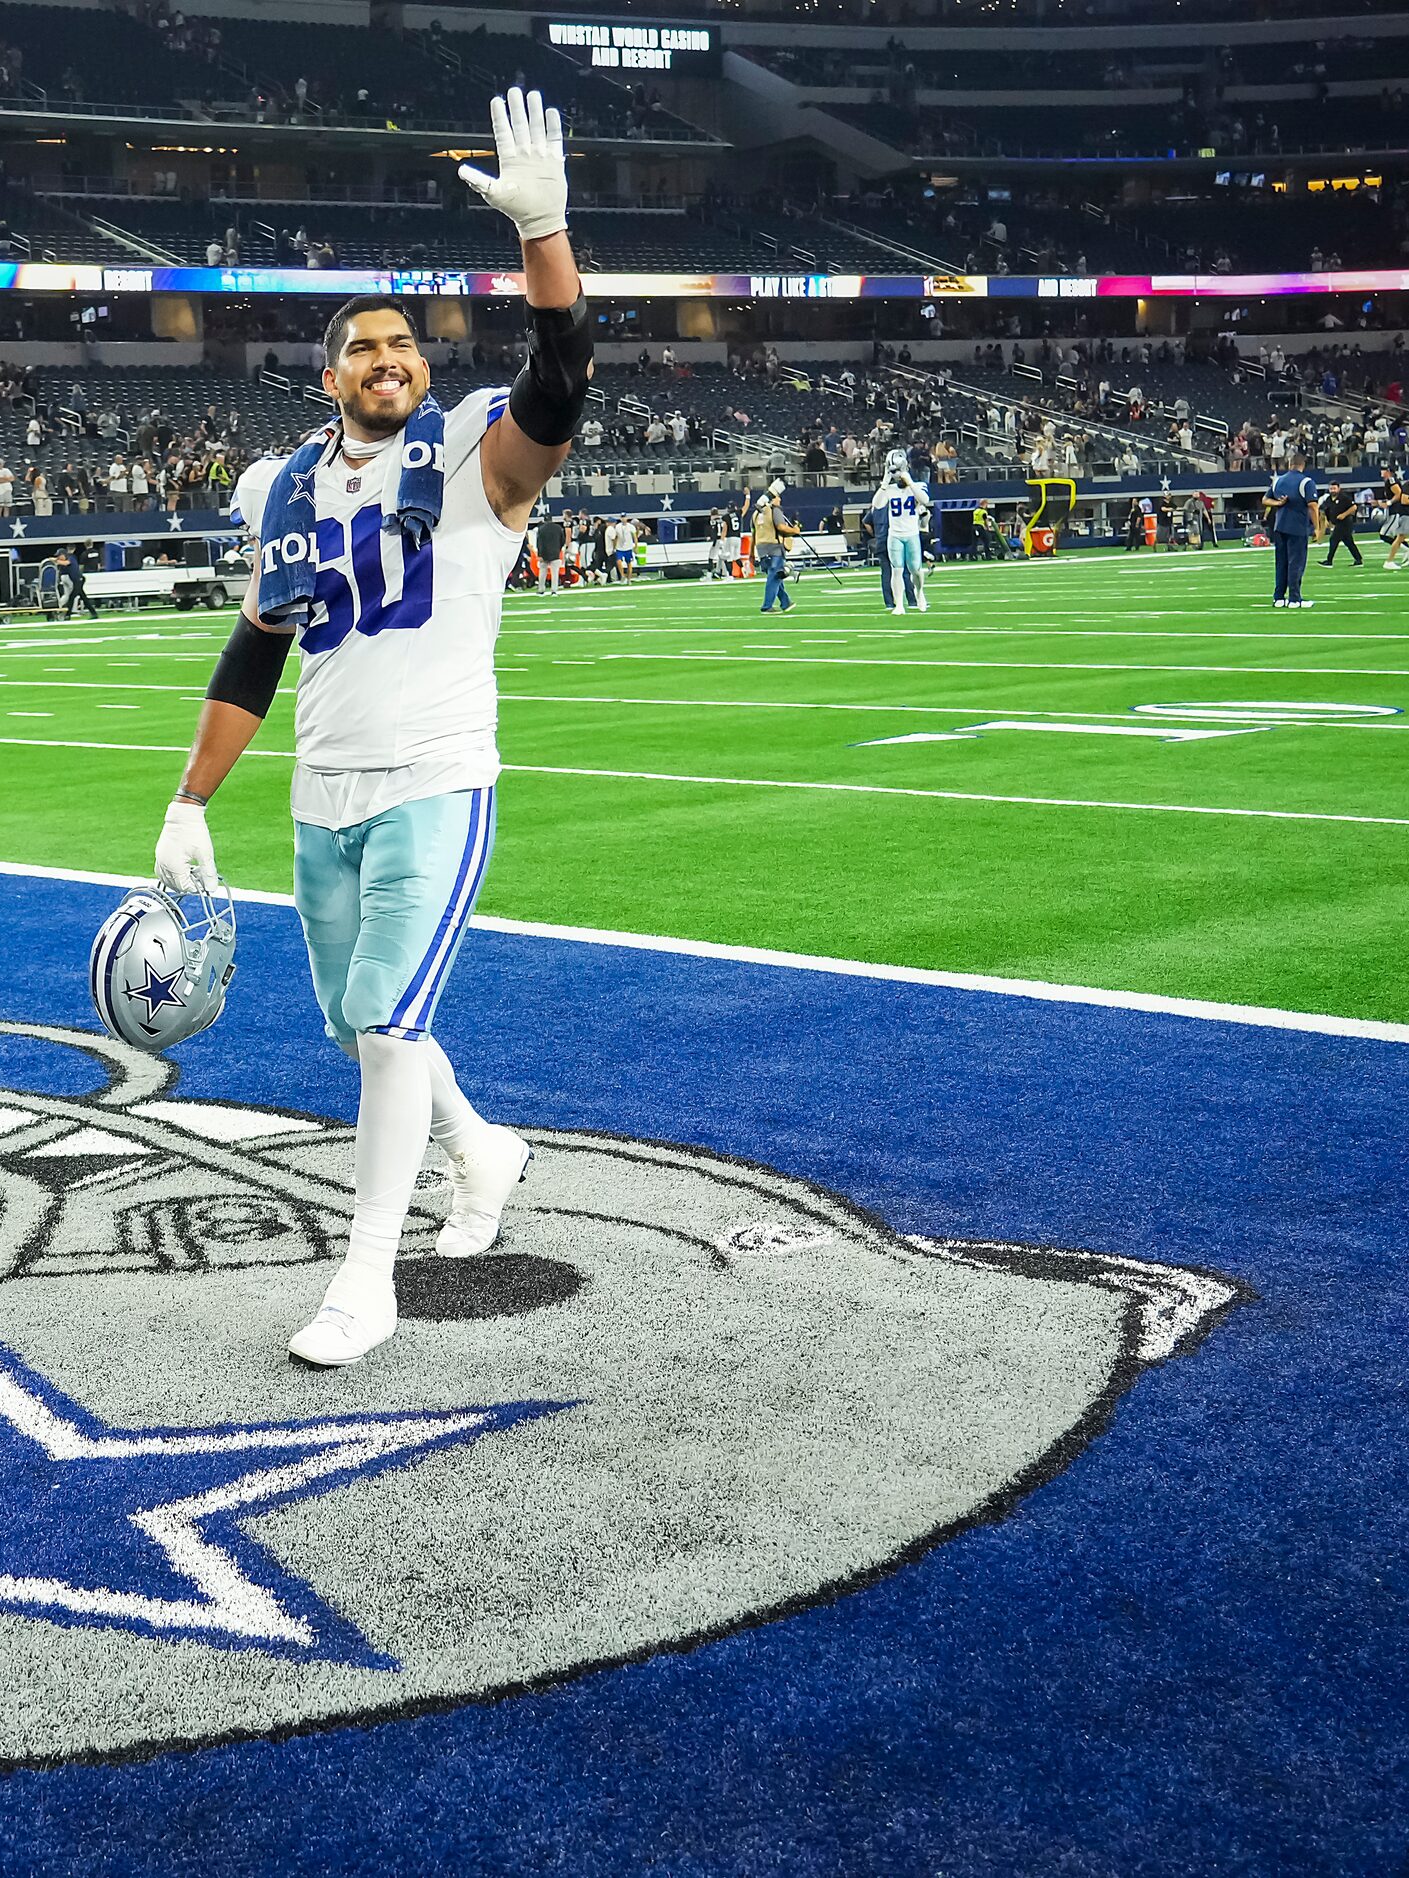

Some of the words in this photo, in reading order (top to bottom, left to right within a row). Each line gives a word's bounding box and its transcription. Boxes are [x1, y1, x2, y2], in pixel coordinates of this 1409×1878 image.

[548, 24, 610, 47] WINSTAR
[611, 27, 659, 49] WORLD
[661, 29, 710, 51] CASINO
[592, 47, 620, 67] AND
[621, 48, 672, 69] RESORT
[750, 277, 780, 297] PLAY
[781, 277, 806, 297] LIKE
[891, 496, 917, 517] 94
[730, 517, 740, 531] 6
[1043, 533, 1055, 547] G
